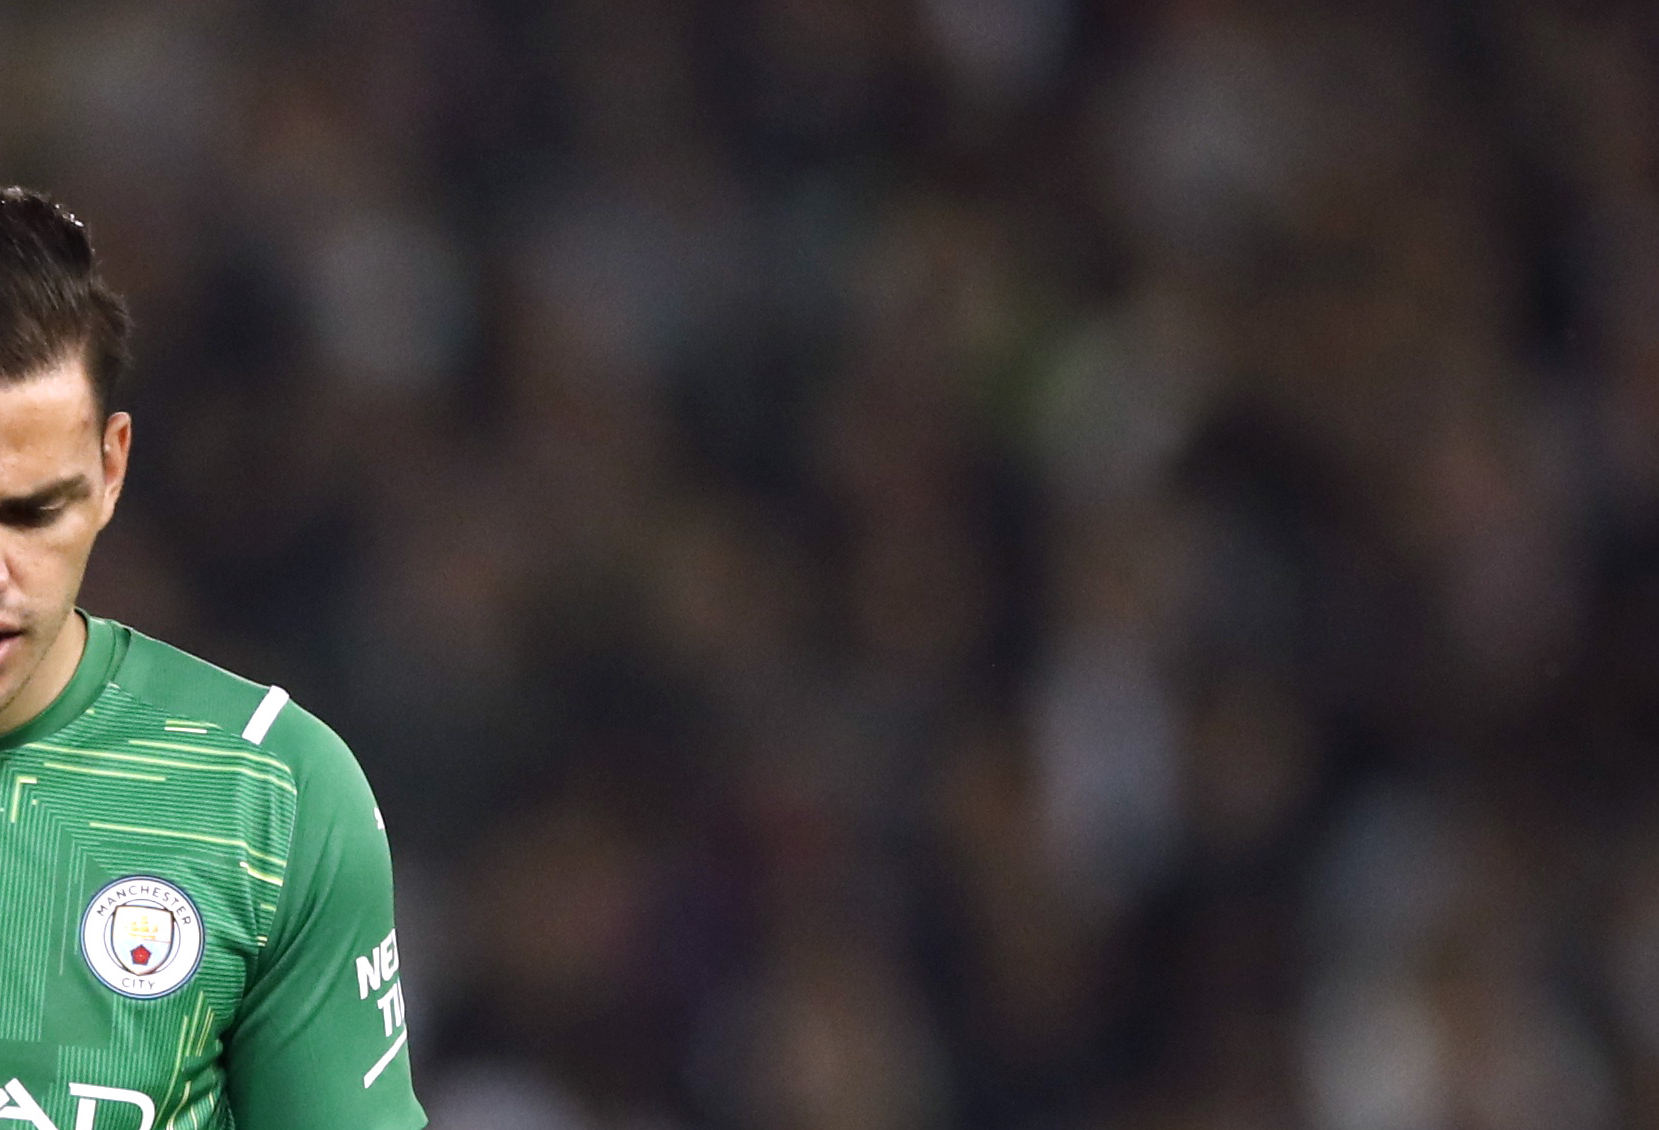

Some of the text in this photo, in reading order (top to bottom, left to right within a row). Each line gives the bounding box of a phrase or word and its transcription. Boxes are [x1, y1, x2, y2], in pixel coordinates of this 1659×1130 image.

[96, 885, 192, 926] MANCHESTER
[121, 977, 156, 990] CITY
[356, 928, 399, 999] NE
